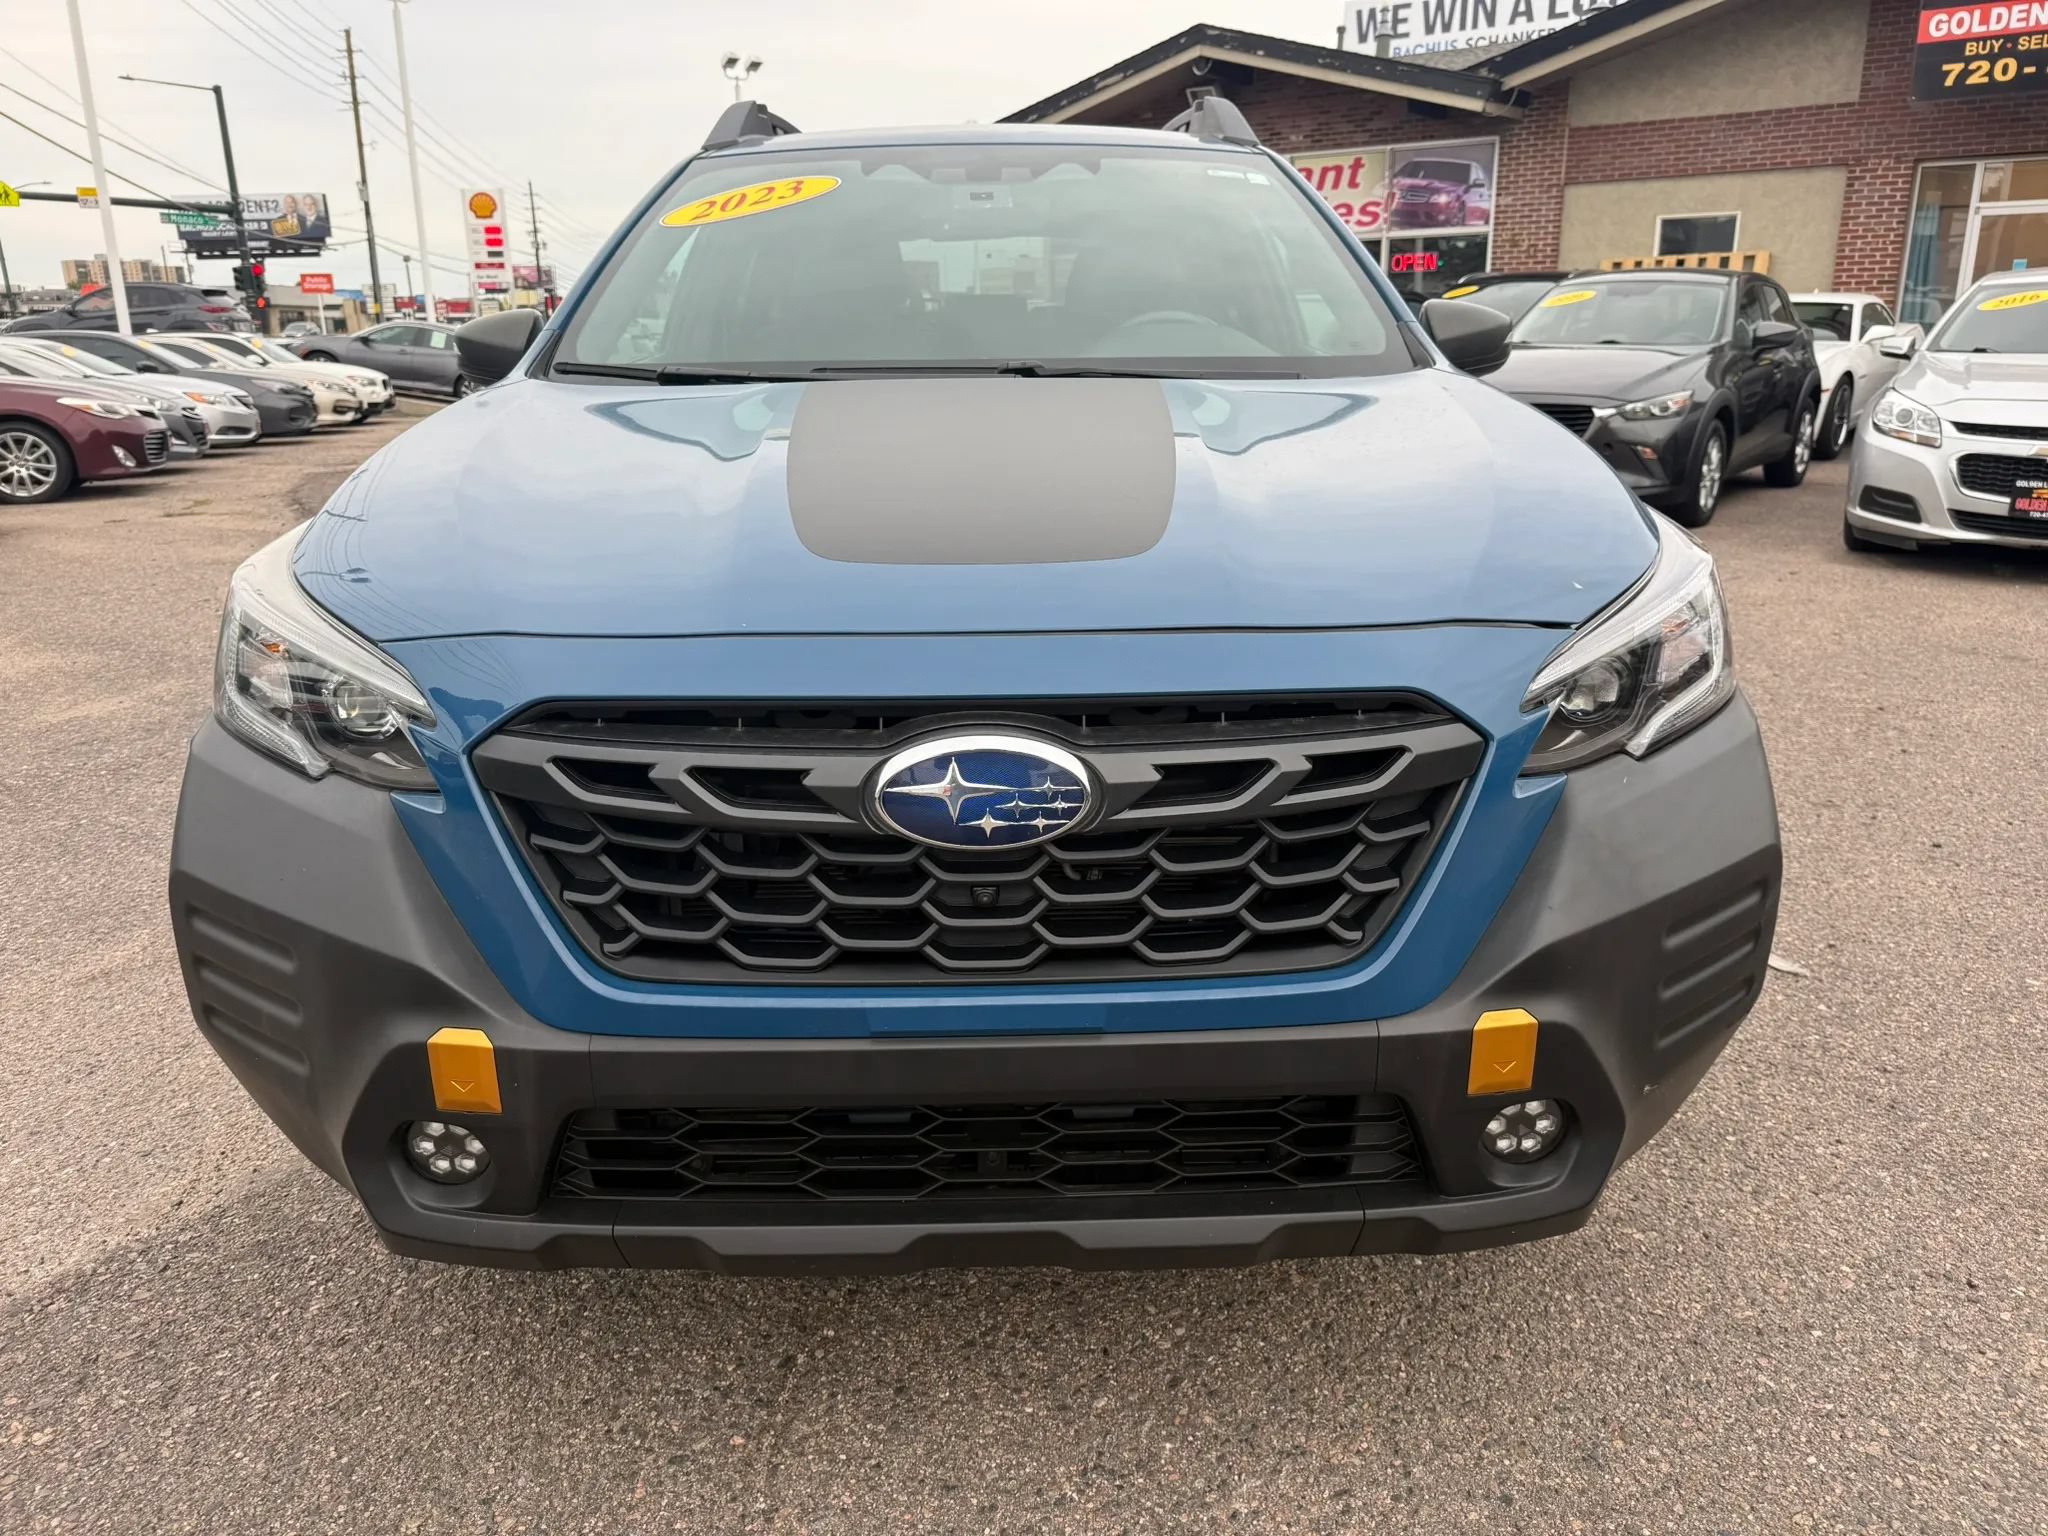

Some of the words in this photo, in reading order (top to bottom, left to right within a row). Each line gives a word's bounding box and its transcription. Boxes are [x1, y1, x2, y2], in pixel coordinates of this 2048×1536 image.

[1356, 3, 1412, 44] WE
[1422, 0, 1497, 36] WIN
[1509, 0, 1535, 26] A
[1928, 2, 2048, 38] GOLDEN
[1965, 38, 2004, 56] BUY
[688, 180, 804, 222] 2023
[170, 214, 204, 225] Monaco
[1391, 253, 1438, 273] OPEN
